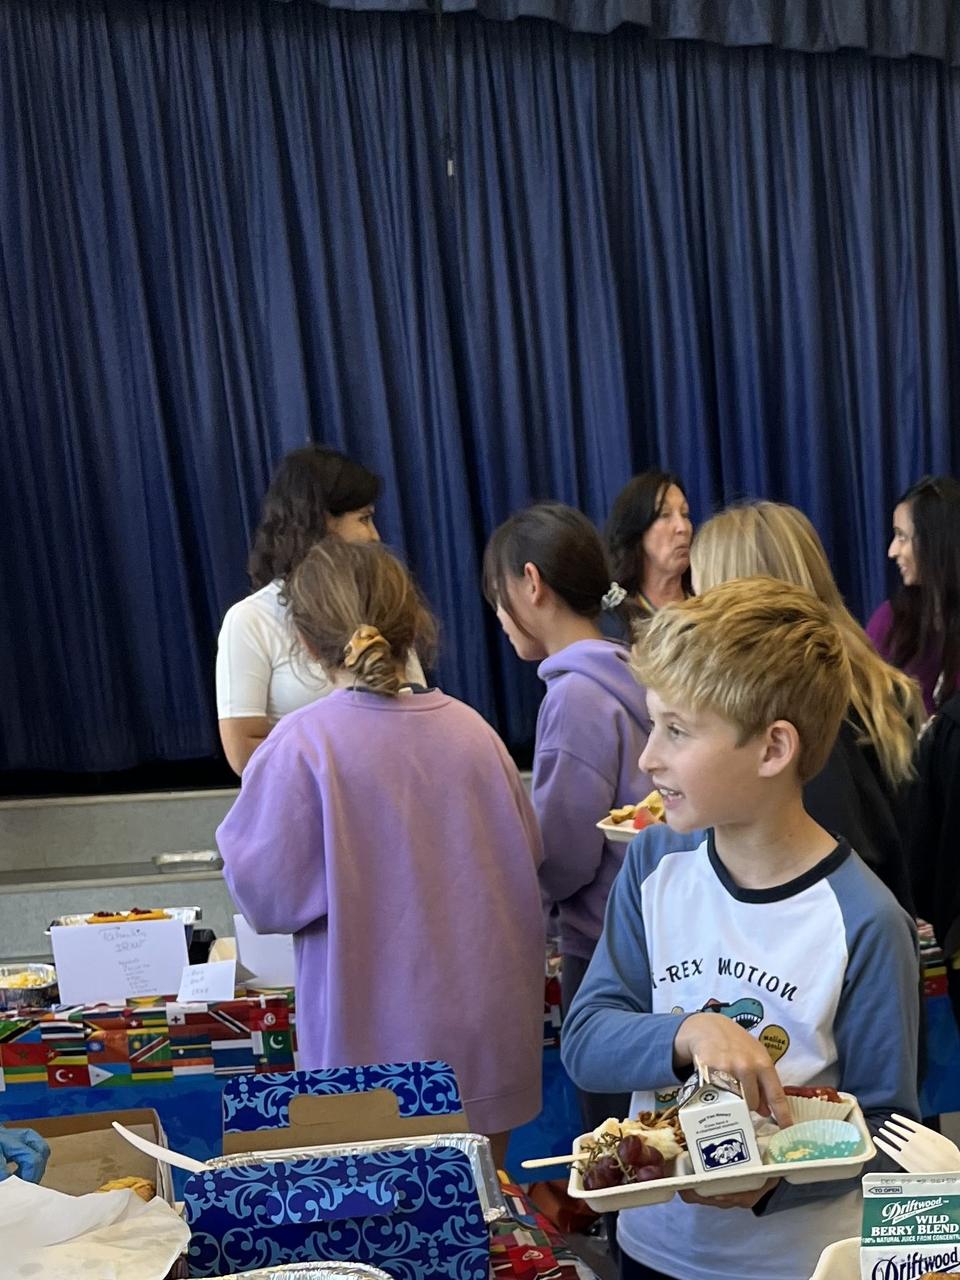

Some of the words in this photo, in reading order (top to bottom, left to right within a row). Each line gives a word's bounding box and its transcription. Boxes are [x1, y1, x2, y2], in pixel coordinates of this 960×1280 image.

[718, 957, 798, 1002] MOTION
[881, 1197, 942, 1223] Driftwood
[915, 1215, 950, 1224] WILD
[871, 1225, 915, 1236] BERRY
[917, 1224, 959, 1234] BLEND
